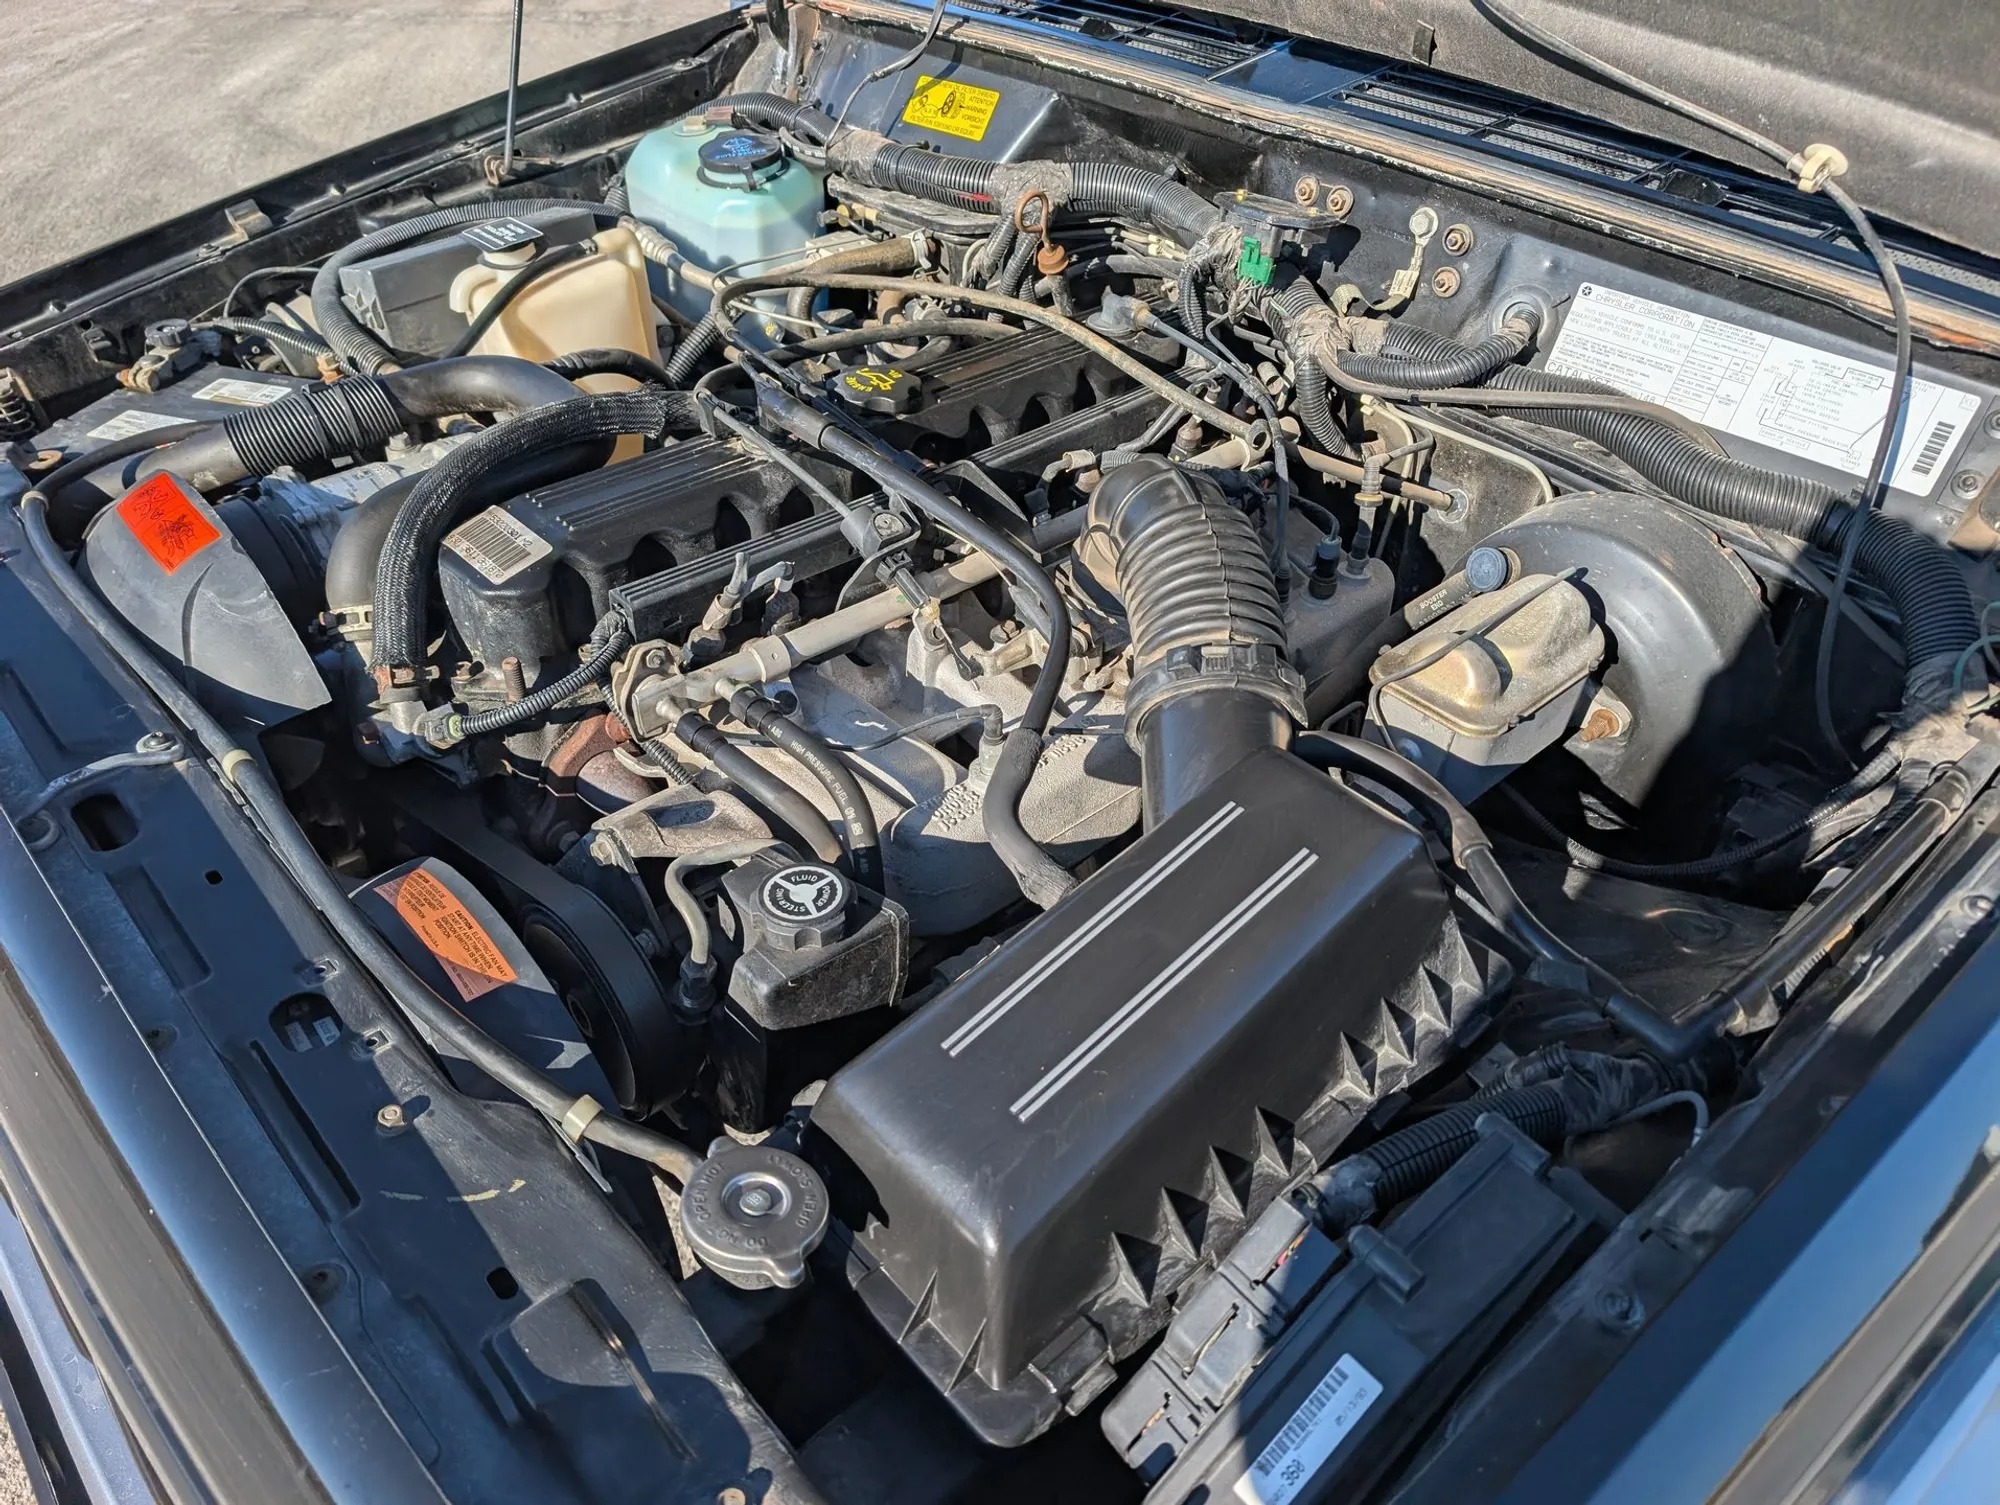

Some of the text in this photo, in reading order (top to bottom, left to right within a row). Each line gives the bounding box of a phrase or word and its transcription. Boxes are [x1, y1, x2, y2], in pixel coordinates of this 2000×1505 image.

[968, 96, 994, 106] ATTENTION
[1594, 293, 1696, 329] CHRYSLER CORPORATION
[1419, 589, 1448, 608] BOOSTER
[1430, 600, 1443, 610] END
[790, 740, 807, 756] HIGH
[804, 750, 835, 783] PRESSURE
[832, 780, 849, 808] FUEL
[790, 874, 818, 883] FLUID
[775, 887, 807, 912] STEERING
[815, 885, 831, 907] POWER
[432, 919, 452, 938] POSITION
[439, 916, 458, 934] IGNITION
[453, 933, 472, 951] SWITCH
[446, 913, 461, 926] START
[462, 931, 473, 941] ANY
[469, 941, 482, 953] TIME
[477, 953, 494, 968] WHEN
[453, 909, 509, 977] CAUTION ELECTRIC FAN MAY
[691, 1189, 712, 1223] OPEN
